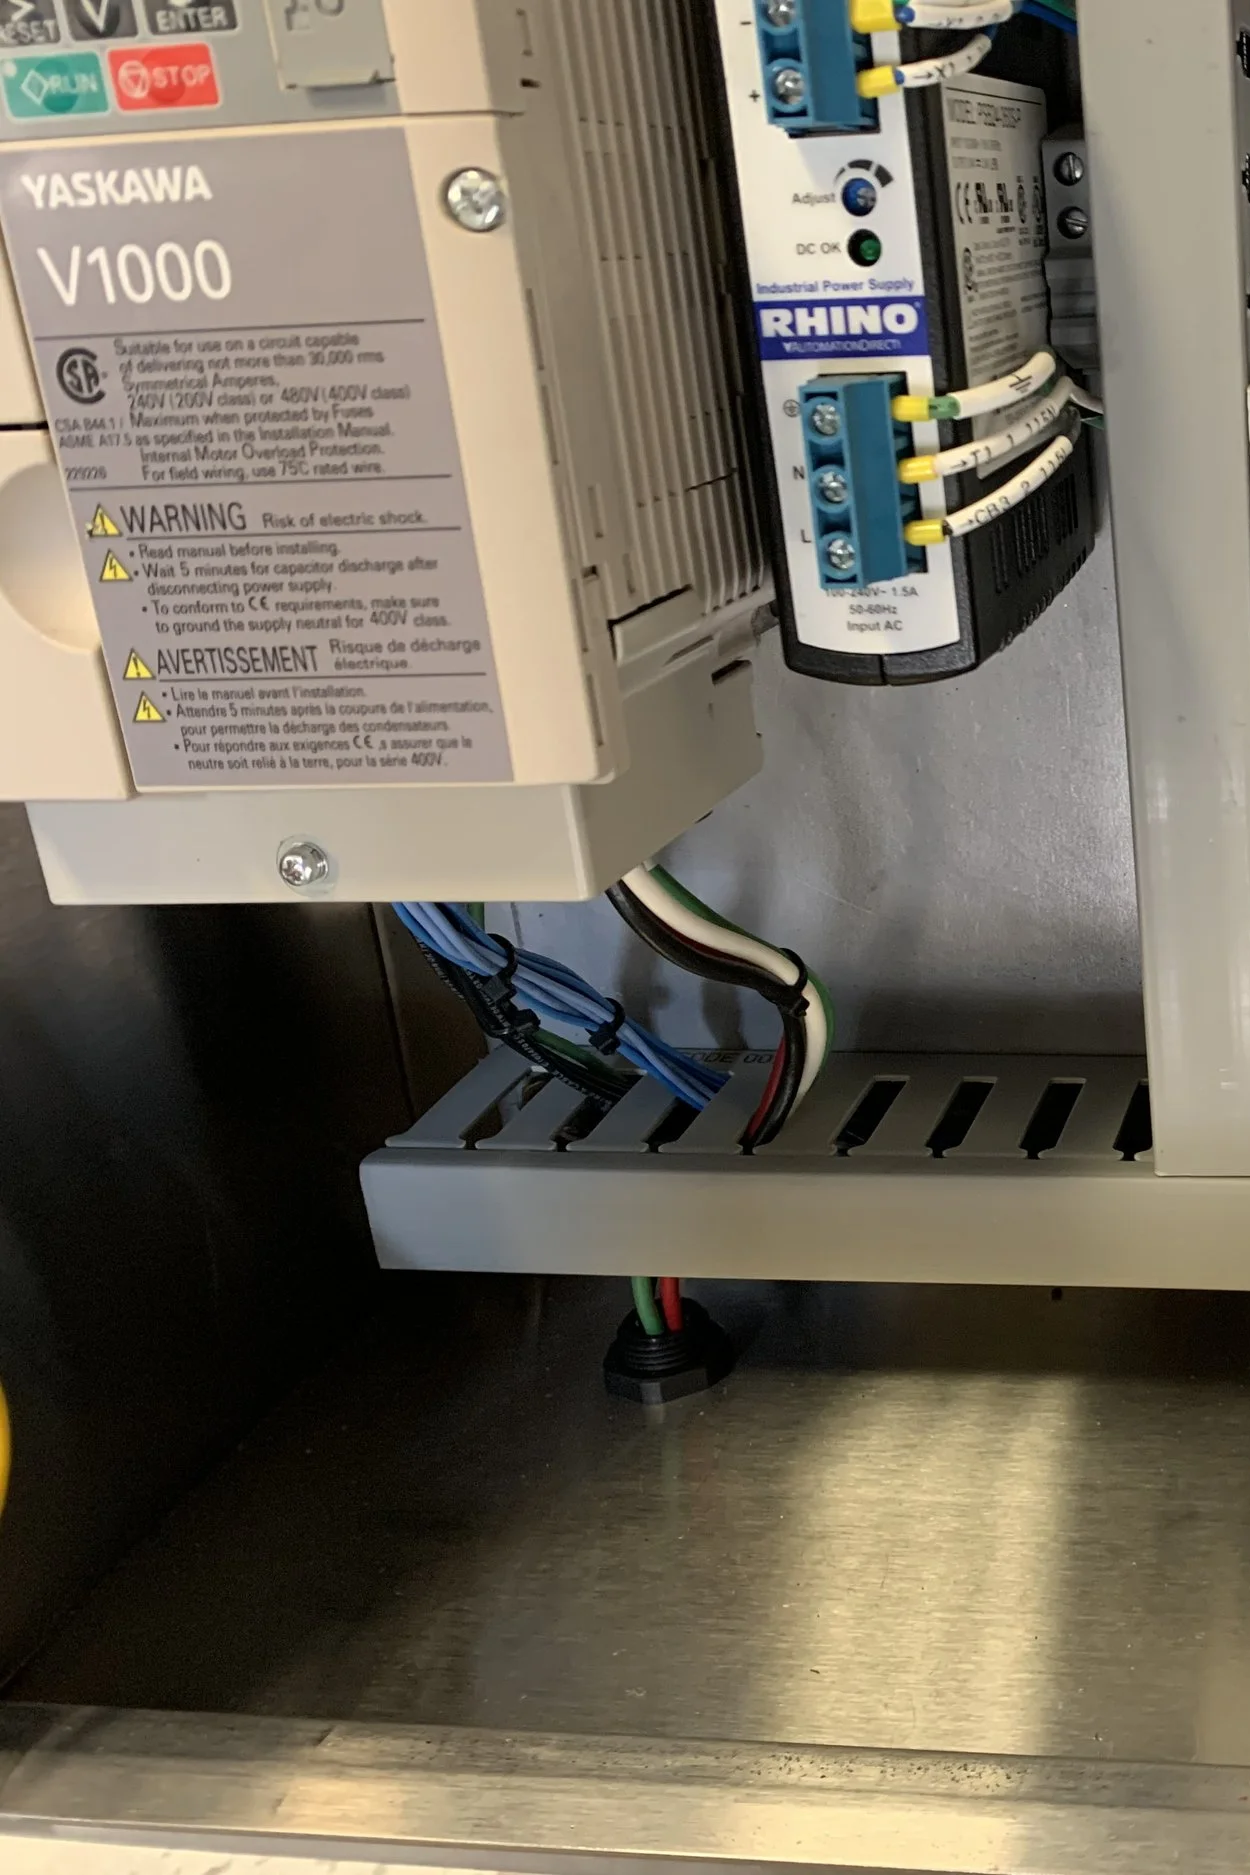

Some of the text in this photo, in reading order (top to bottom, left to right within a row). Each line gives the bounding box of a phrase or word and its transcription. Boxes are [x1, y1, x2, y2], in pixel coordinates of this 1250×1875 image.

[156, 7, 227, 32] ENTER
[50, 72, 98, 95] RUN
[151, 64, 212, 89] STOP
[20, 164, 213, 211] YASKAWA
[792, 192, 836, 207] Adjust
[796, 242, 842, 255] DC OK
[37, 239, 232, 307] V1000
[756, 276, 915, 295] Industrial Power Supply
[759, 302, 919, 338] RHINO
[114, 334, 360, 356] Suitable for use circuit capable
[137, 353, 305, 375] delivering not more than
[121, 373, 208, 393] Symmetrical
[129, 403, 374, 428] Maximum when protected by Fuses
[153, 425, 335, 448] specified the Installation
[140, 442, 306, 464] Internal Motor Overload
[141, 462, 349, 482] For field rated
[792, 466, 805, 480] N
[119, 501, 247, 534] WARNING
[262, 511, 375, 529] Risk electric
[801, 529, 812, 544] L
[138, 542, 273, 560] Read manual before
[141, 556, 438, 579] Wait minutes for capacitor discharge after
[147, 580, 284, 597] disconnecting power
[892, 585, 919, 597] 1.5A
[151, 595, 441, 615] To conform make sure
[848, 603, 899, 616] 50-60Hz
[172, 609, 409, 636] ground the supply neutral for 400V
[847, 620, 903, 633] Input AC
[329, 637, 407, 656] Risque de
[156, 645, 319, 677] AVERTISSEMENT
[170, 685, 290, 702] Lire manuel avant
[176, 702, 388, 718] Attendre minutes coupure
[180, 720, 360, 739] pour permettre des
[183, 736, 459, 754] Pour aux exigences assurer que
[188, 755, 363, 771] neutre soit pour
